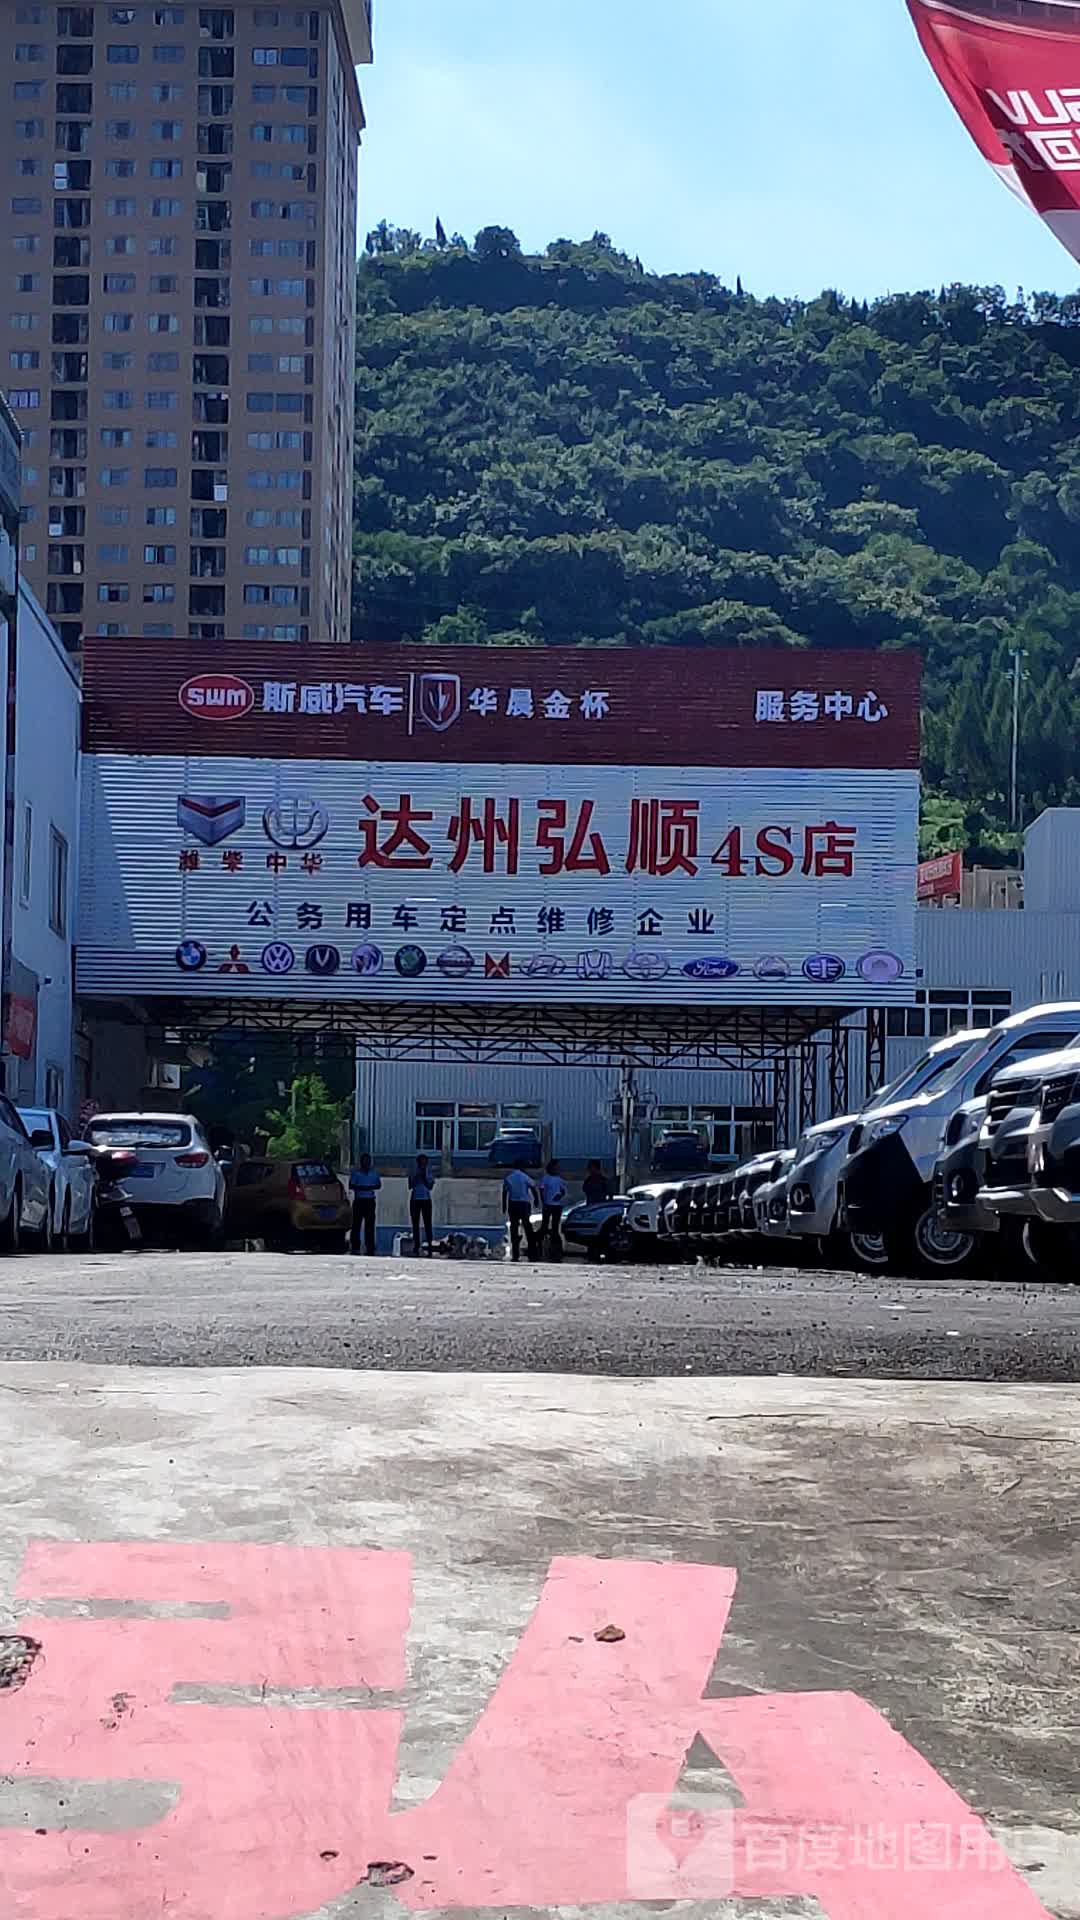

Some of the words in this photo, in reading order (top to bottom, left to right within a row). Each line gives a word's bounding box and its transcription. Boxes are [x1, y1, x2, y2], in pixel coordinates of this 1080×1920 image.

[262, 682, 405, 717] 斯威汽车
[468, 687, 612, 718] 华晨金杯
[754, 689, 890, 722] 服务中心
[358, 794, 858, 876] 达州弘顺4S店
[248, 900, 716, 934] 公务用车定点维修企业
